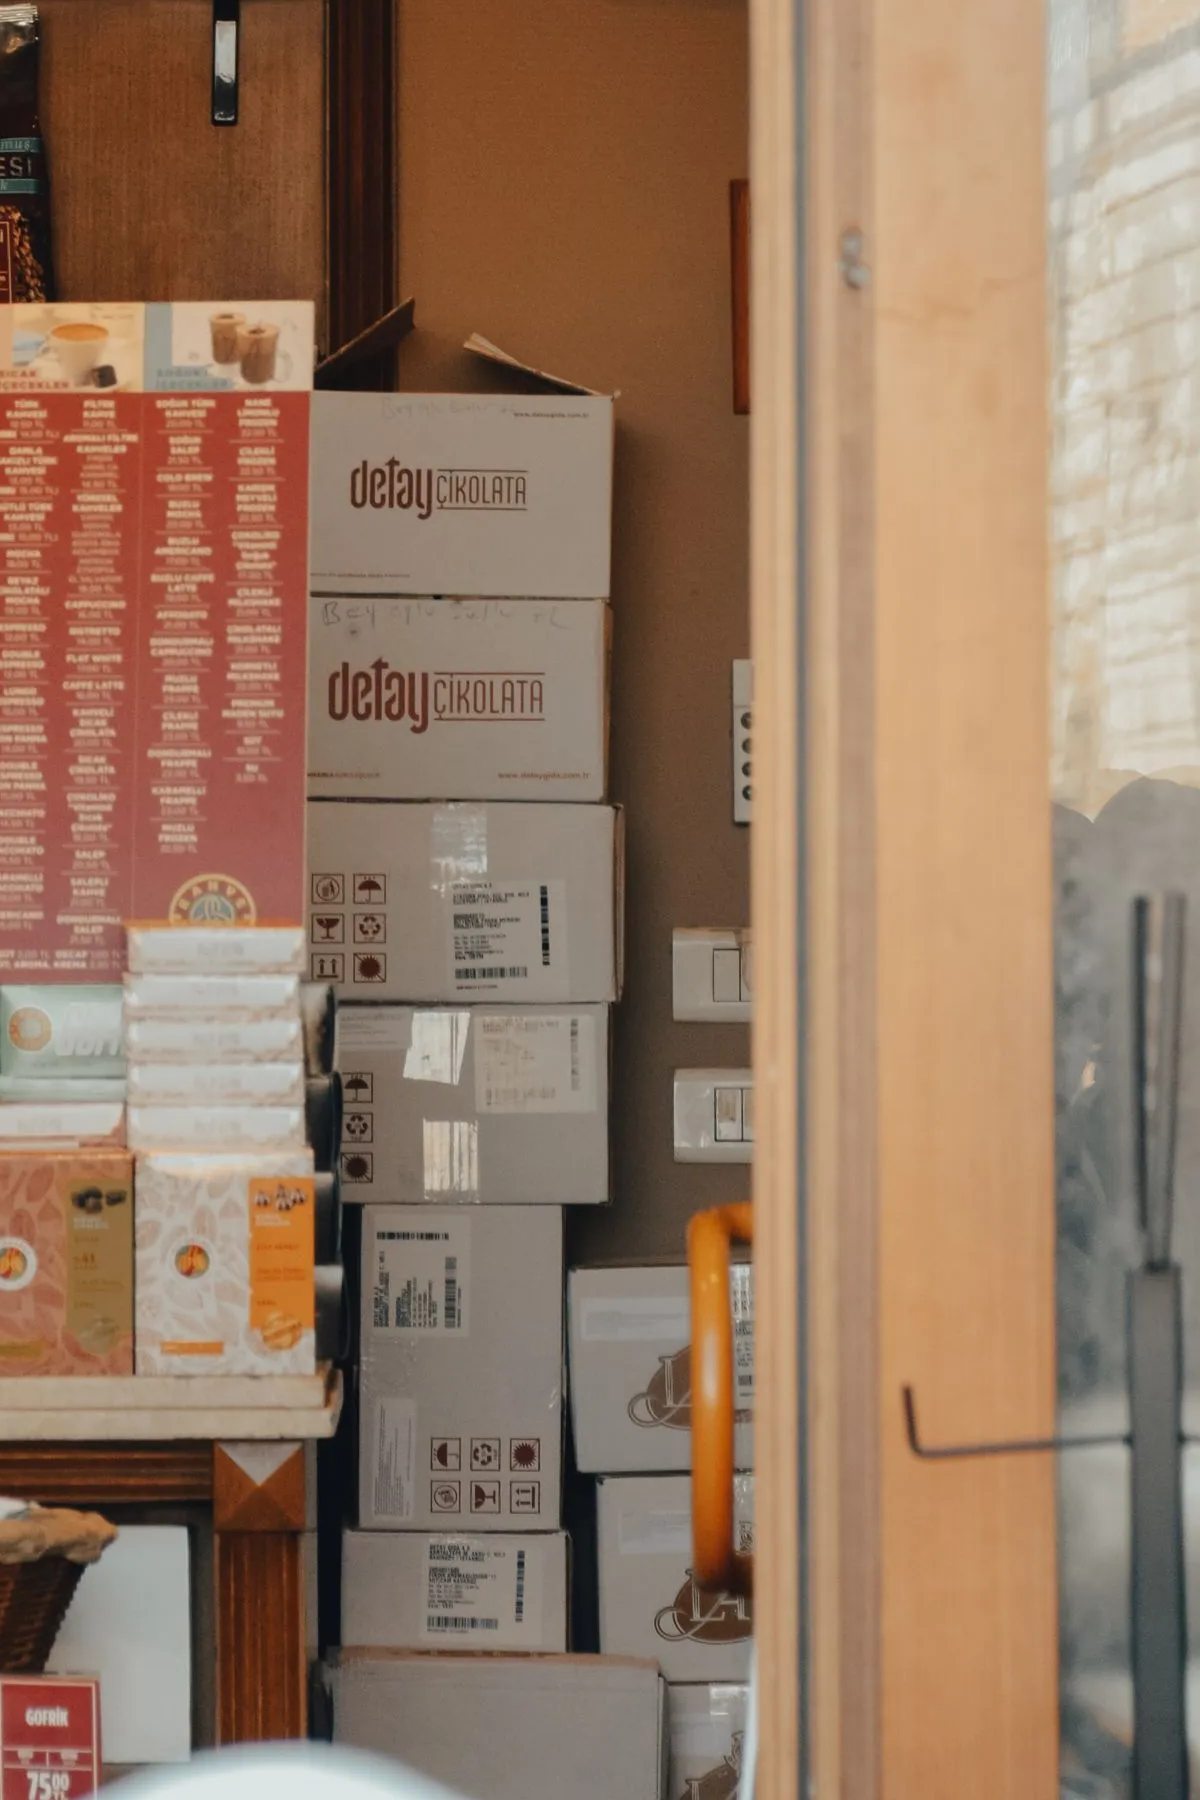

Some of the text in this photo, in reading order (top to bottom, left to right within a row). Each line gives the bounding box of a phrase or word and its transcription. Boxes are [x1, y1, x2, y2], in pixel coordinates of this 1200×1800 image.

[350, 455, 528, 520] detay ÇİKOLATA
[328, 656, 545, 734] detay ÇİKOLATA
[24, 1704, 70, 1729] GOFRİK
